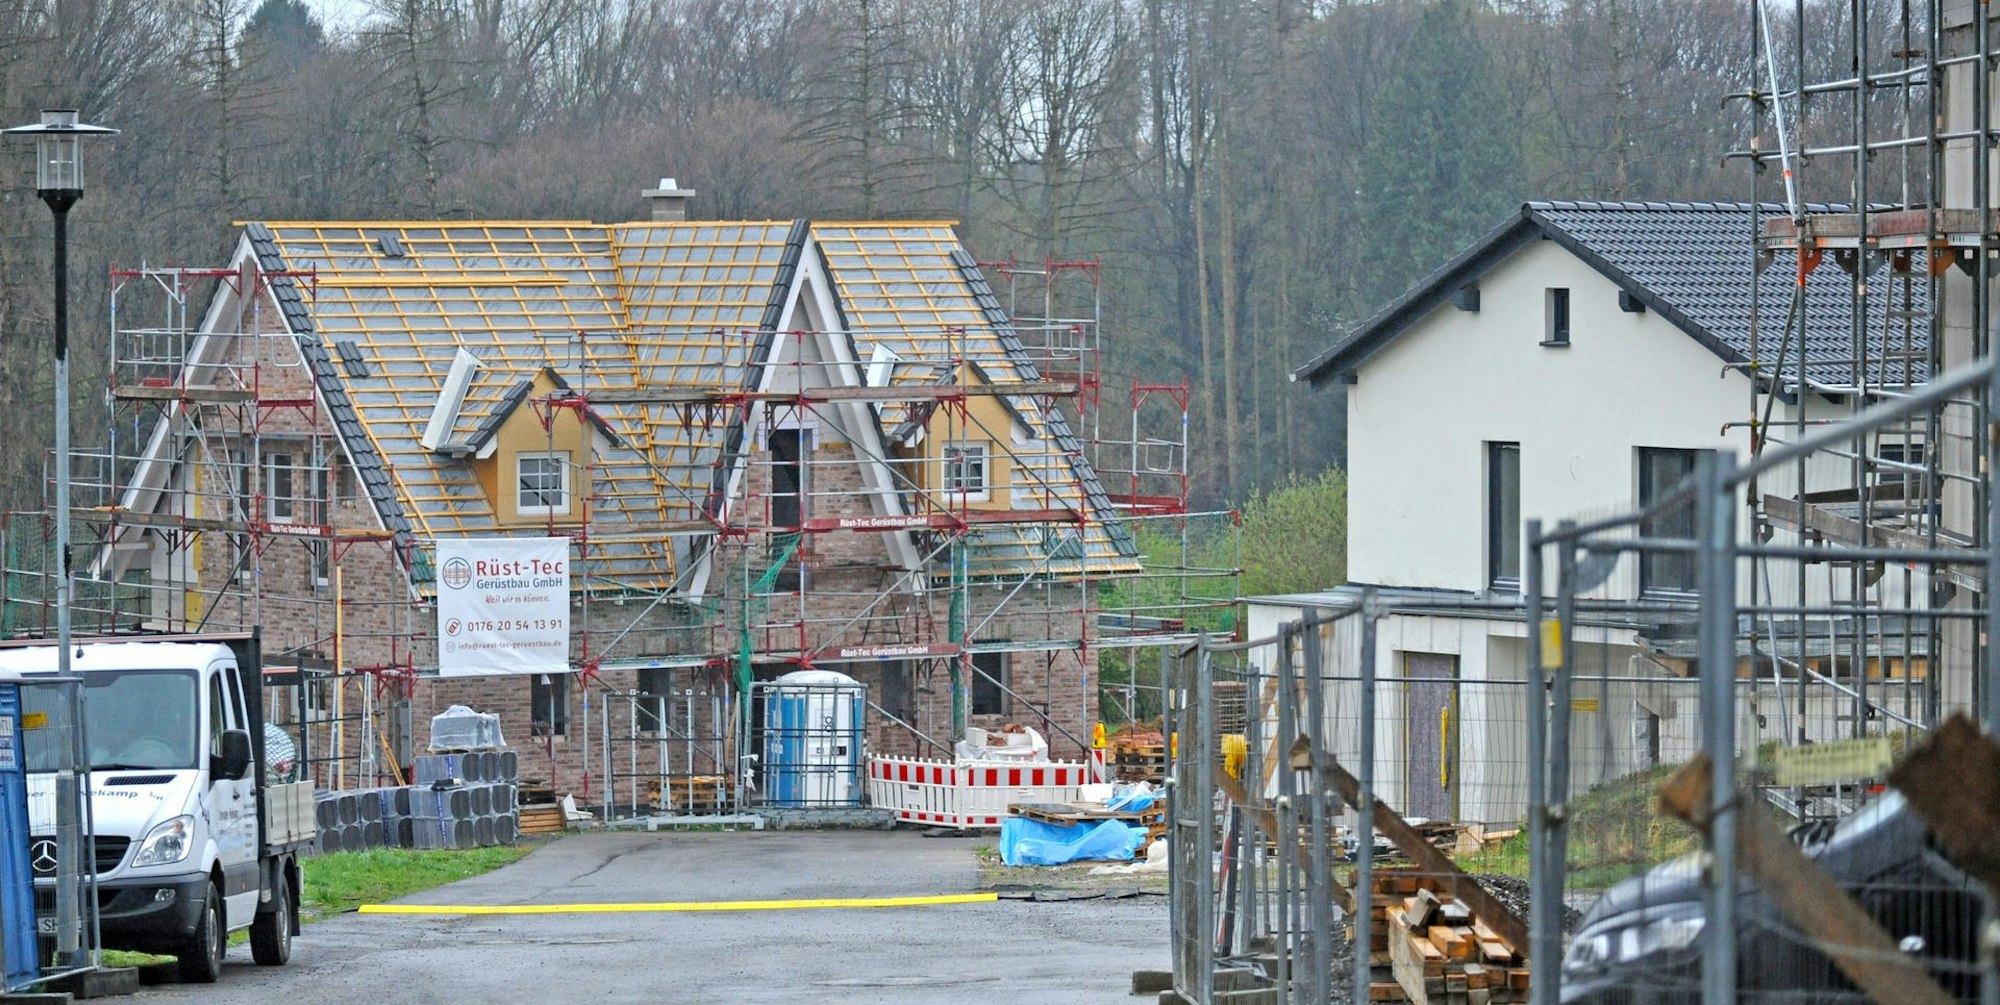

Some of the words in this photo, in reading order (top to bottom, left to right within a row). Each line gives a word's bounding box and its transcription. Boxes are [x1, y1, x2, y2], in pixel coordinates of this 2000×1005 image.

[840, 518, 869, 527] Rüst-Tec
[871, 518, 905, 527] Gerüstbau
[906, 517, 927, 525] GmbH
[476, 559, 563, 576] Rüst-Tec
[476, 578, 530, 590] Gerüstbau
[532, 577, 563, 588] GmbH
[485, 595, 500, 604] Weil
[502, 594, 513, 604] wir
[467, 621, 493, 632] 0176
[497, 620, 511, 631] 20
[516, 620, 529, 631] 54
[534, 619, 546, 630] 13
[550, 619, 562, 629] 91
[458, 640, 562, 650] info@ruest-tec-geruestbau.de
[841, 648, 870, 657] Rüst-Tec
[872, 647, 906, 656] Gerüstbau
[907, 646, 928, 654] GmbH
